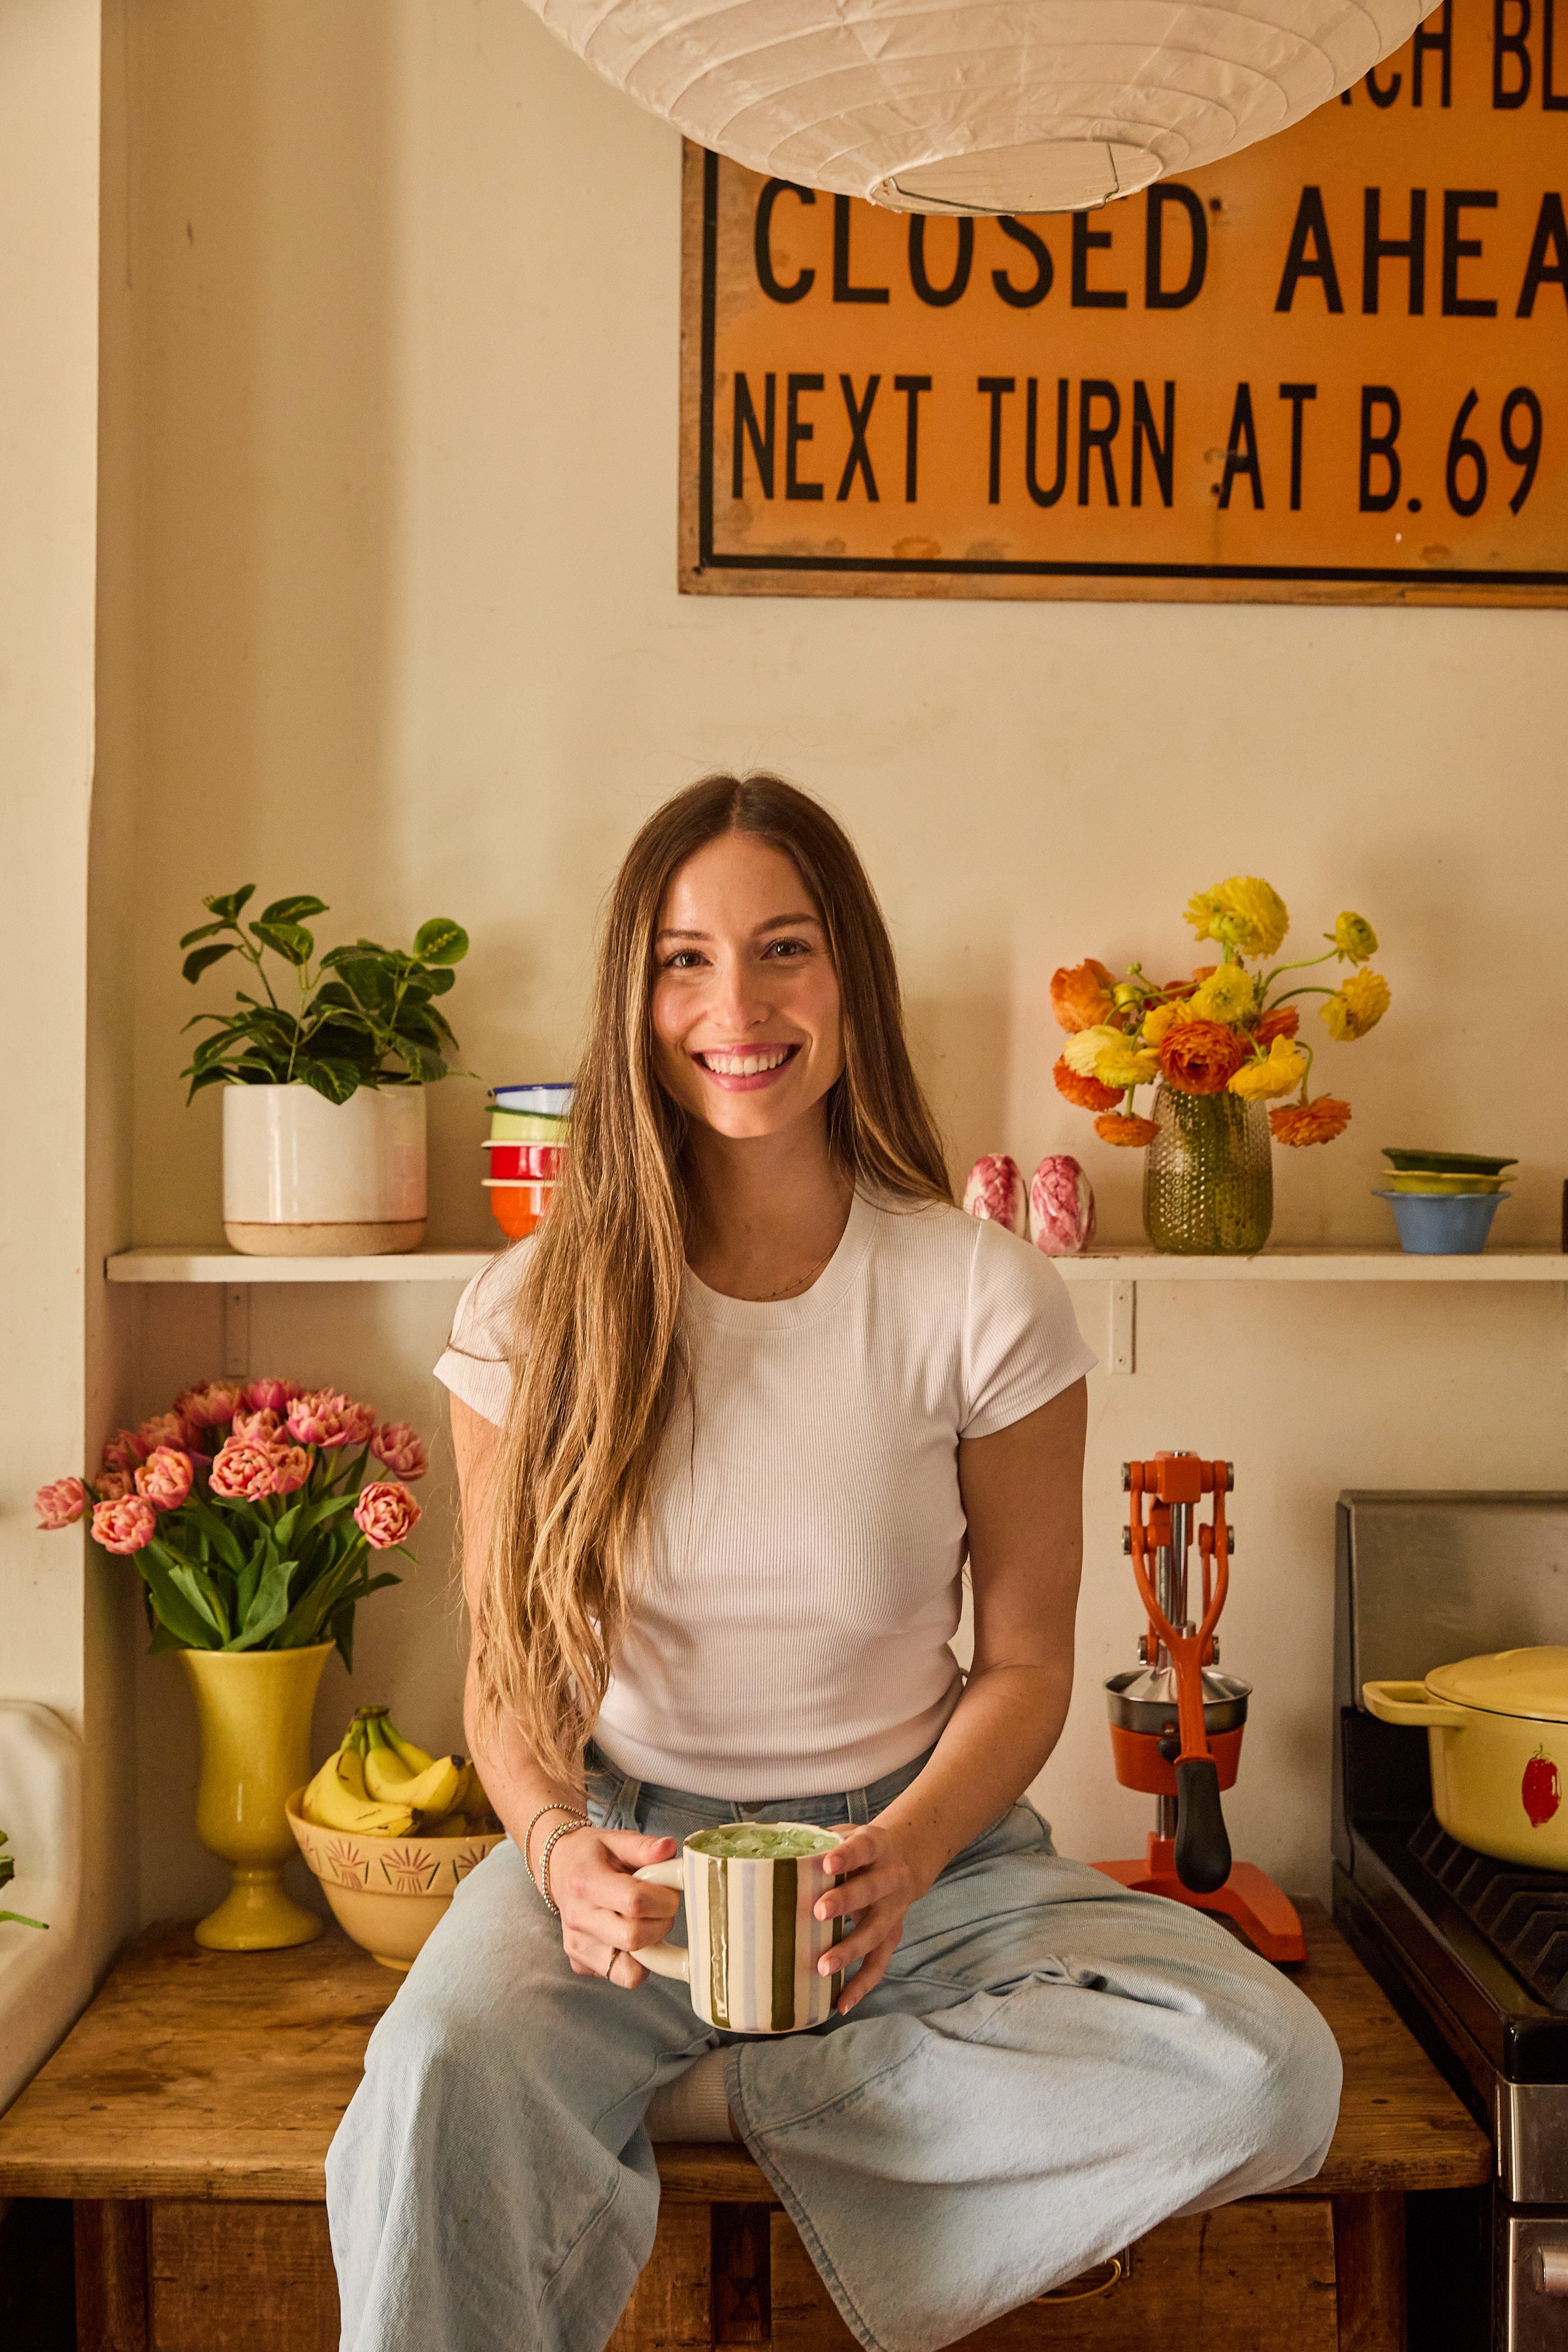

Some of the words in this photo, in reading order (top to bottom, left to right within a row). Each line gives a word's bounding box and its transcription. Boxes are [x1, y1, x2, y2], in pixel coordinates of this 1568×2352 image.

[754, 177, 1209, 310] CLOSED
[1274, 186, 1568, 319] AHEA
[732, 372, 932, 502] NEXT
[977, 377, 1176, 508] TURN
[1217, 382, 1317, 511] AT
